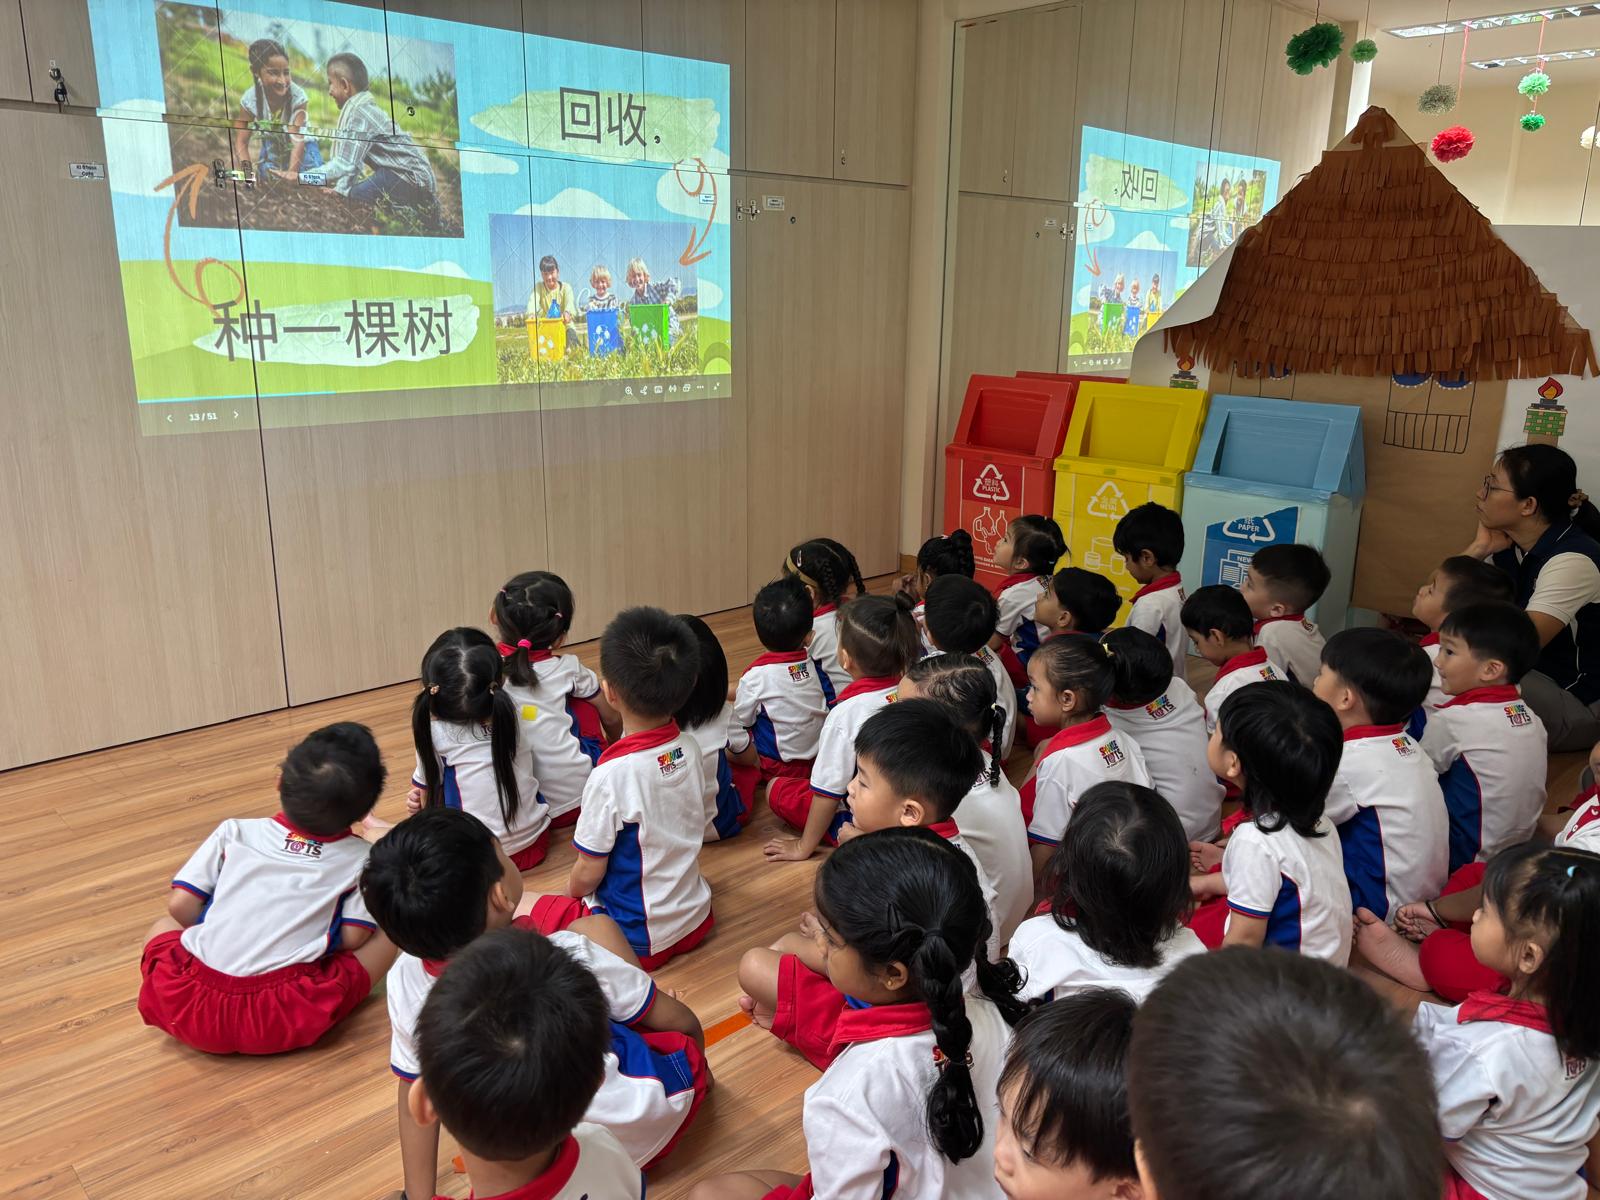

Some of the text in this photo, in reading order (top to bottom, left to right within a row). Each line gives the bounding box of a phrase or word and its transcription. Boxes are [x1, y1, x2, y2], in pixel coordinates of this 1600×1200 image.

[560, 87, 647, 147] 回收
[213, 299, 452, 361] 种一棵树
[189, 413, 200, 421] 13
[207, 412, 218, 420] 51
[982, 485, 1001, 493] PLASTIC
[1237, 523, 1260, 533] PAPER
[1103, 749, 1124, 766] TOTS
[285, 839, 321, 856] TOTS
